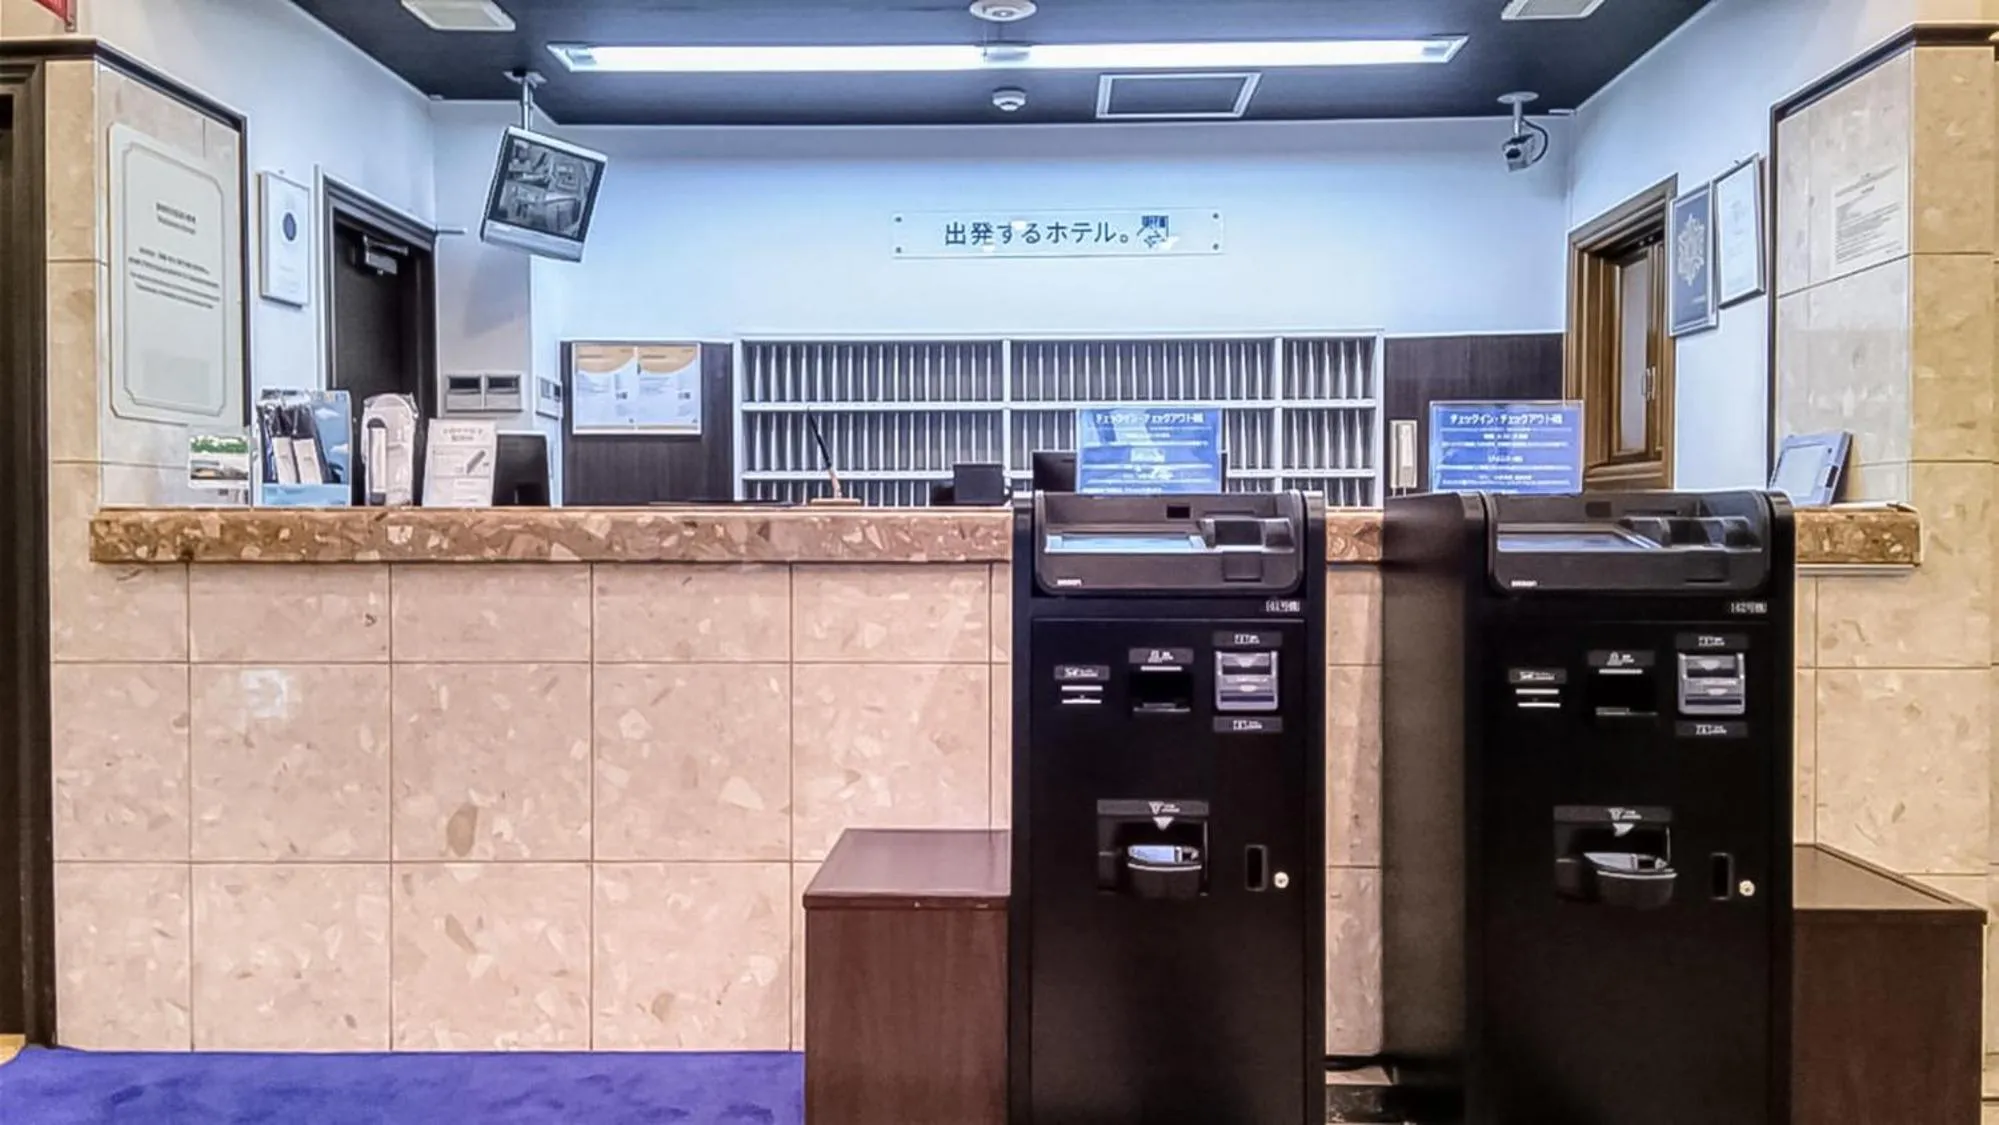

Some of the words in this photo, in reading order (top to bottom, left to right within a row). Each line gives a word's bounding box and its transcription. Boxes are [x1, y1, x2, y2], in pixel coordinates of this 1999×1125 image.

[945, 221, 1129, 245] 出発するホテル。
